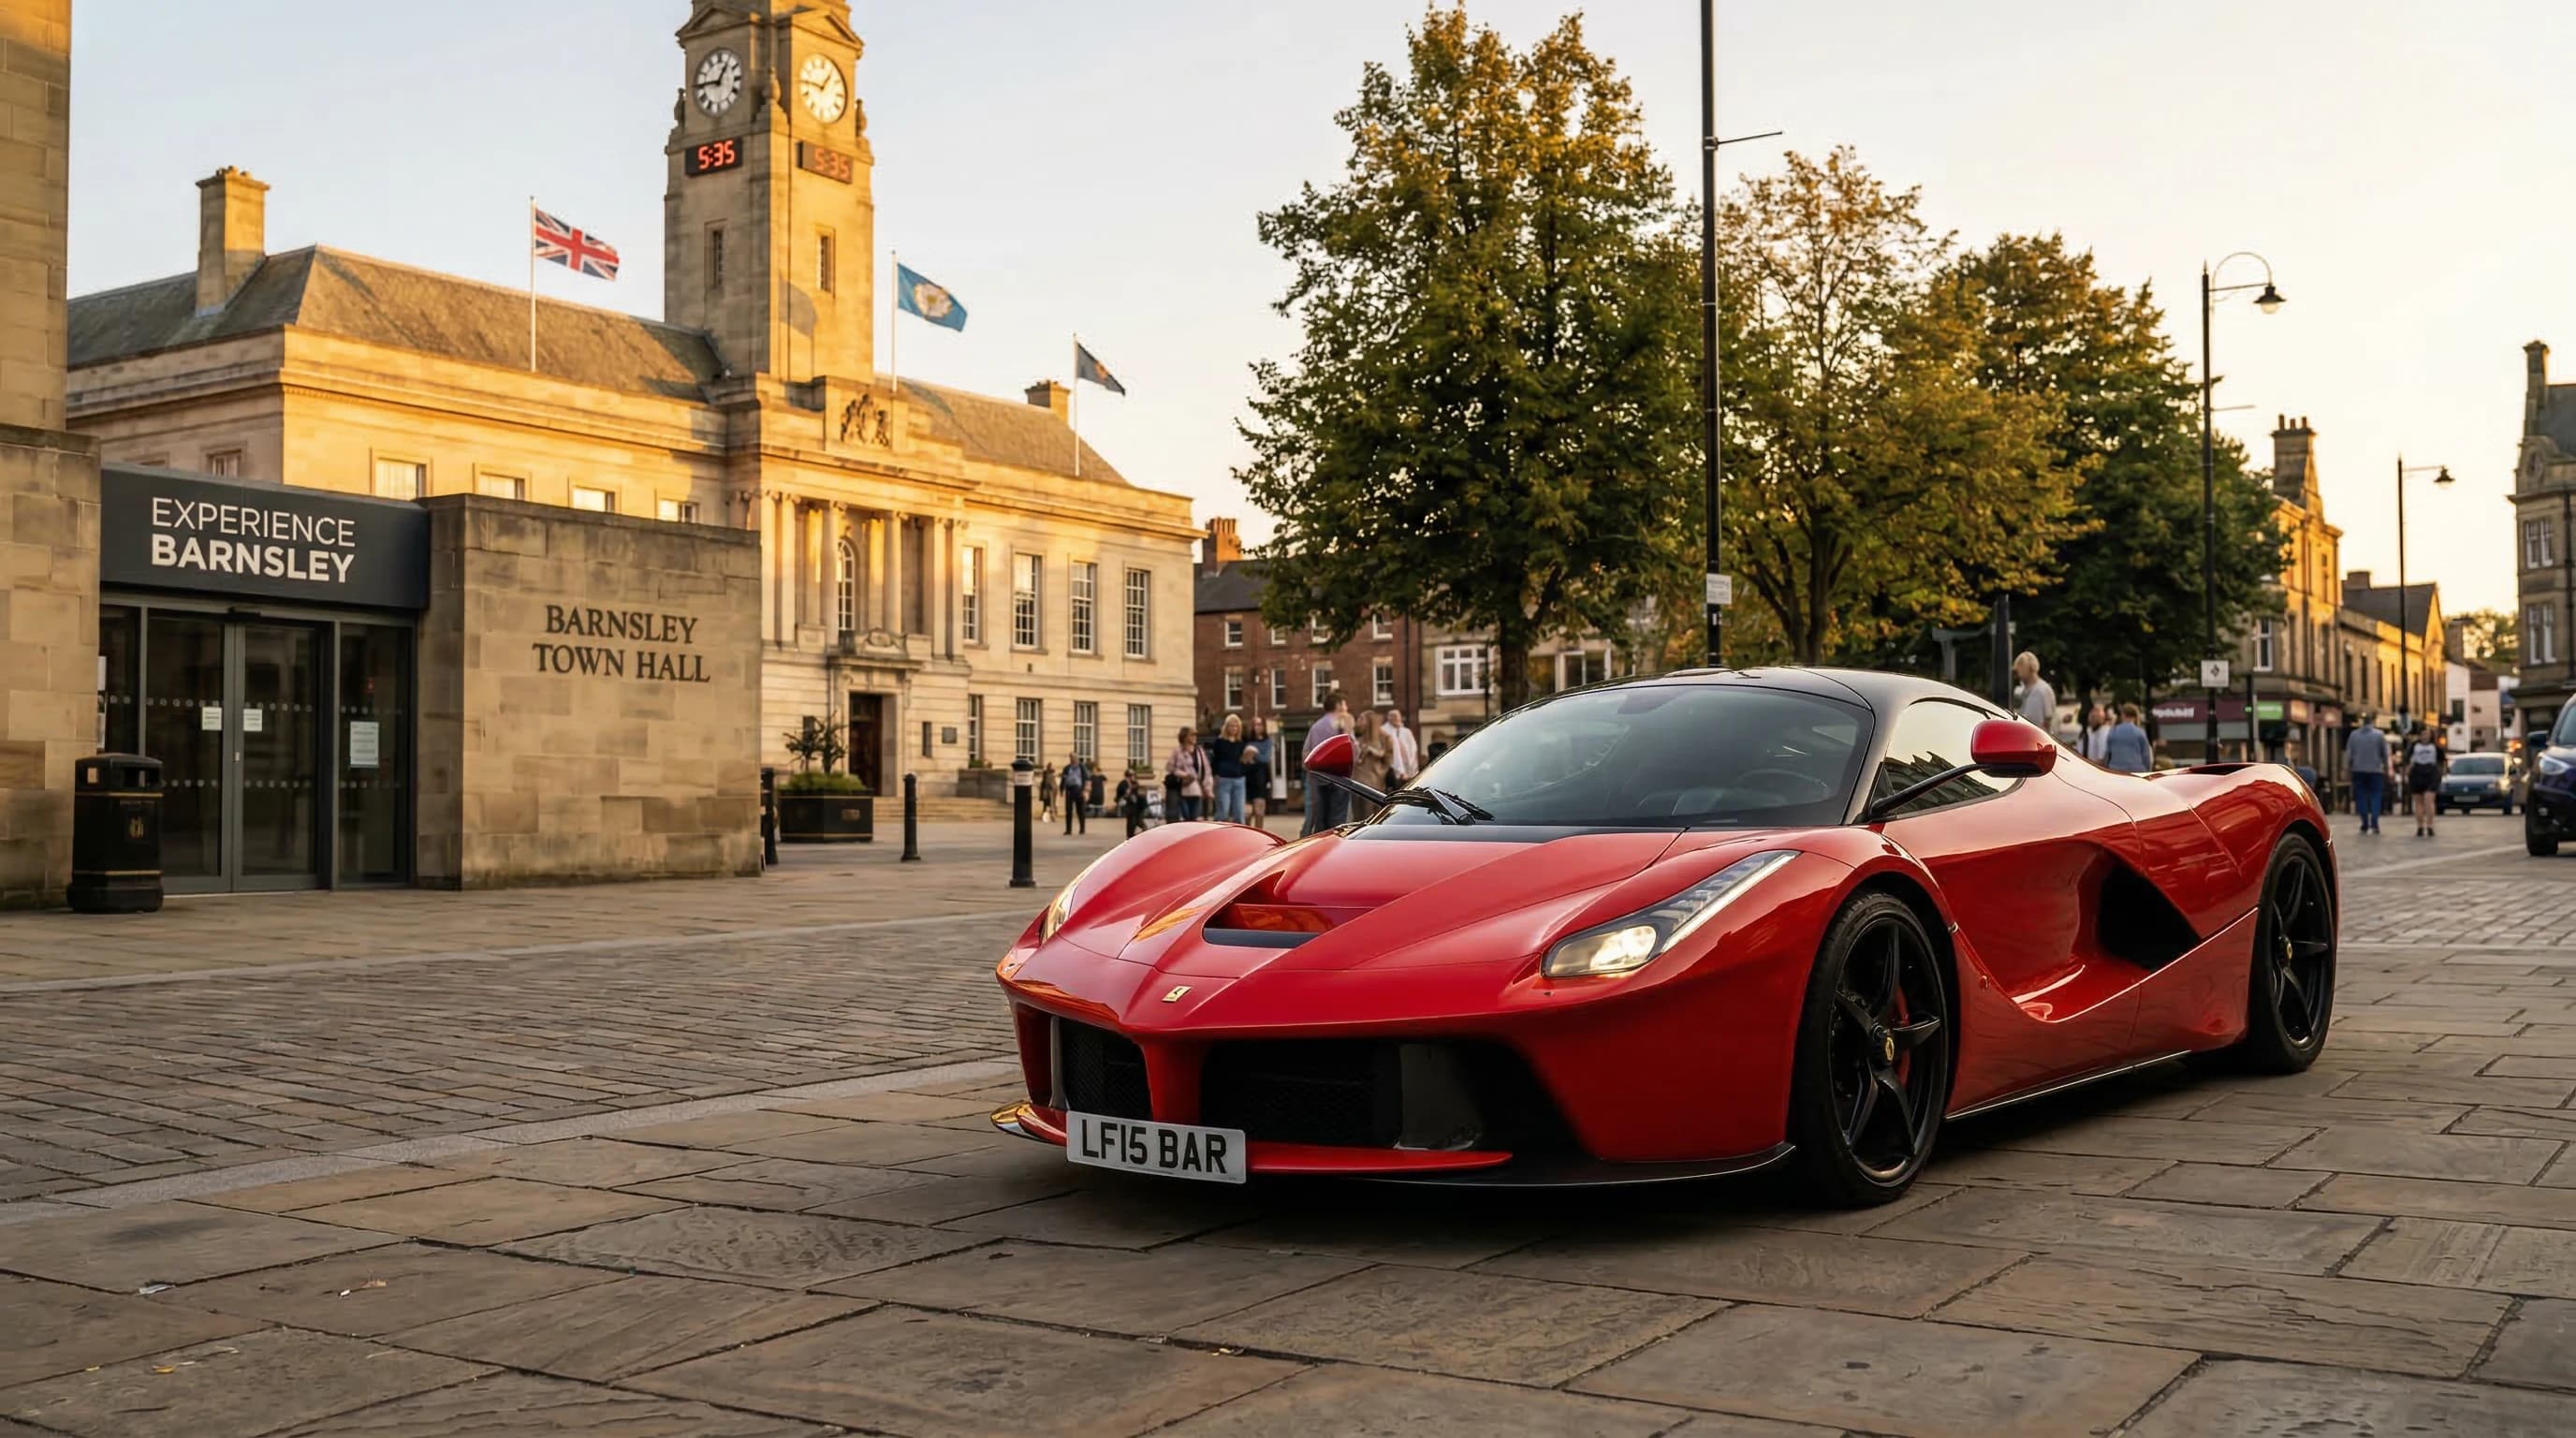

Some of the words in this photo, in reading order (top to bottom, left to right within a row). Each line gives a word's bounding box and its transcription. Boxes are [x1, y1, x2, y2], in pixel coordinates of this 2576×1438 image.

[698, 140, 735, 169] 5:35
[814, 148, 850, 180] 5:35
[152, 496, 356, 548] EXPERIENCE
[151, 533, 356, 584] BARNSLEY
[546, 604, 699, 644] BARNSLEY
[533, 643, 625, 677] TOWN
[636, 652, 710, 683] HALL
[1081, 1119, 1149, 1165] LF15
[1159, 1129, 1227, 1174] BAR
